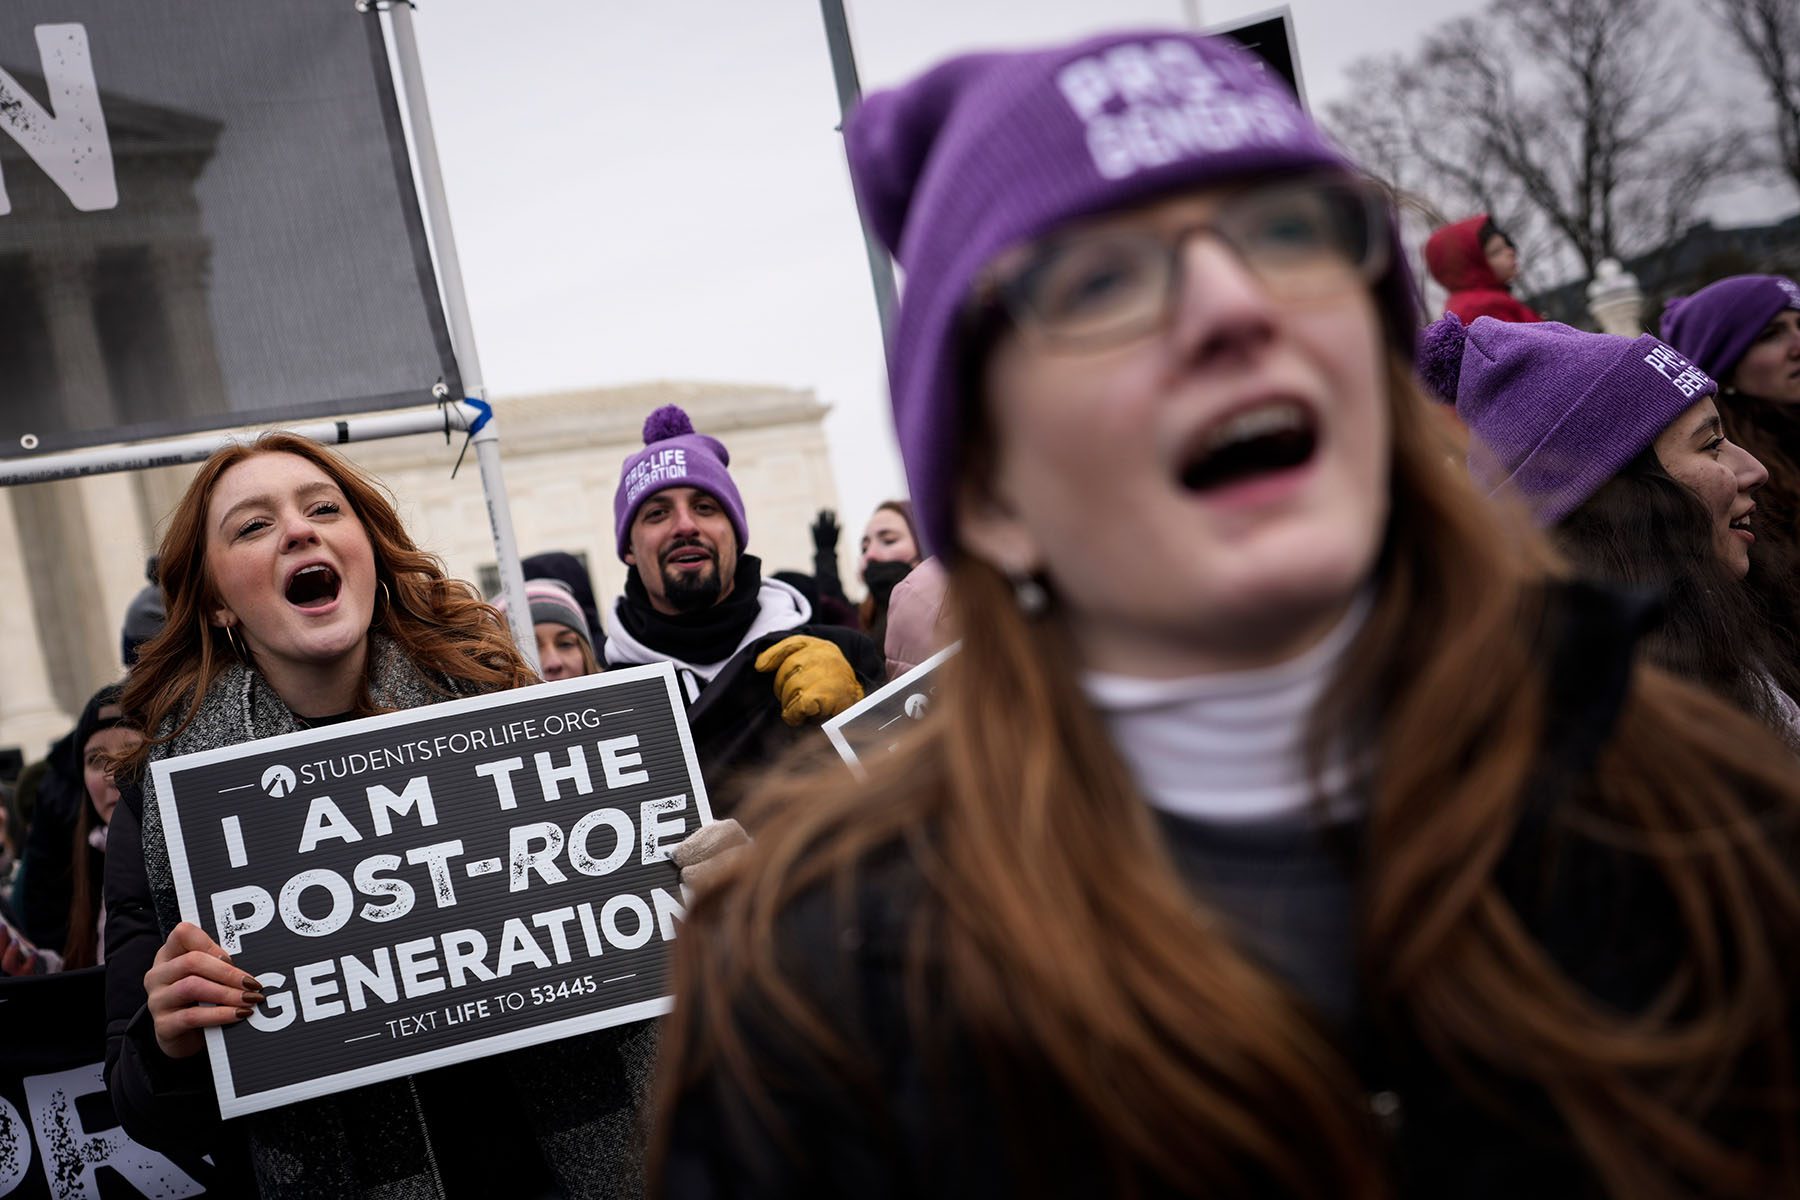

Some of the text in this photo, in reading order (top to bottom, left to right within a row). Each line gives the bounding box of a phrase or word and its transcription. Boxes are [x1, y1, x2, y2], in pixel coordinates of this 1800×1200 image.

[624, 449, 687, 493] PRO-LIFE
[627, 464, 688, 505] GENERATION
[300, 708, 601, 786] STUDENTSFORLIFE.ORG
[221, 734, 650, 868] I AM THE
[211, 794, 687, 956] POST-ROE
[385, 975, 597, 1038] TEXT LIFE TO 53445
